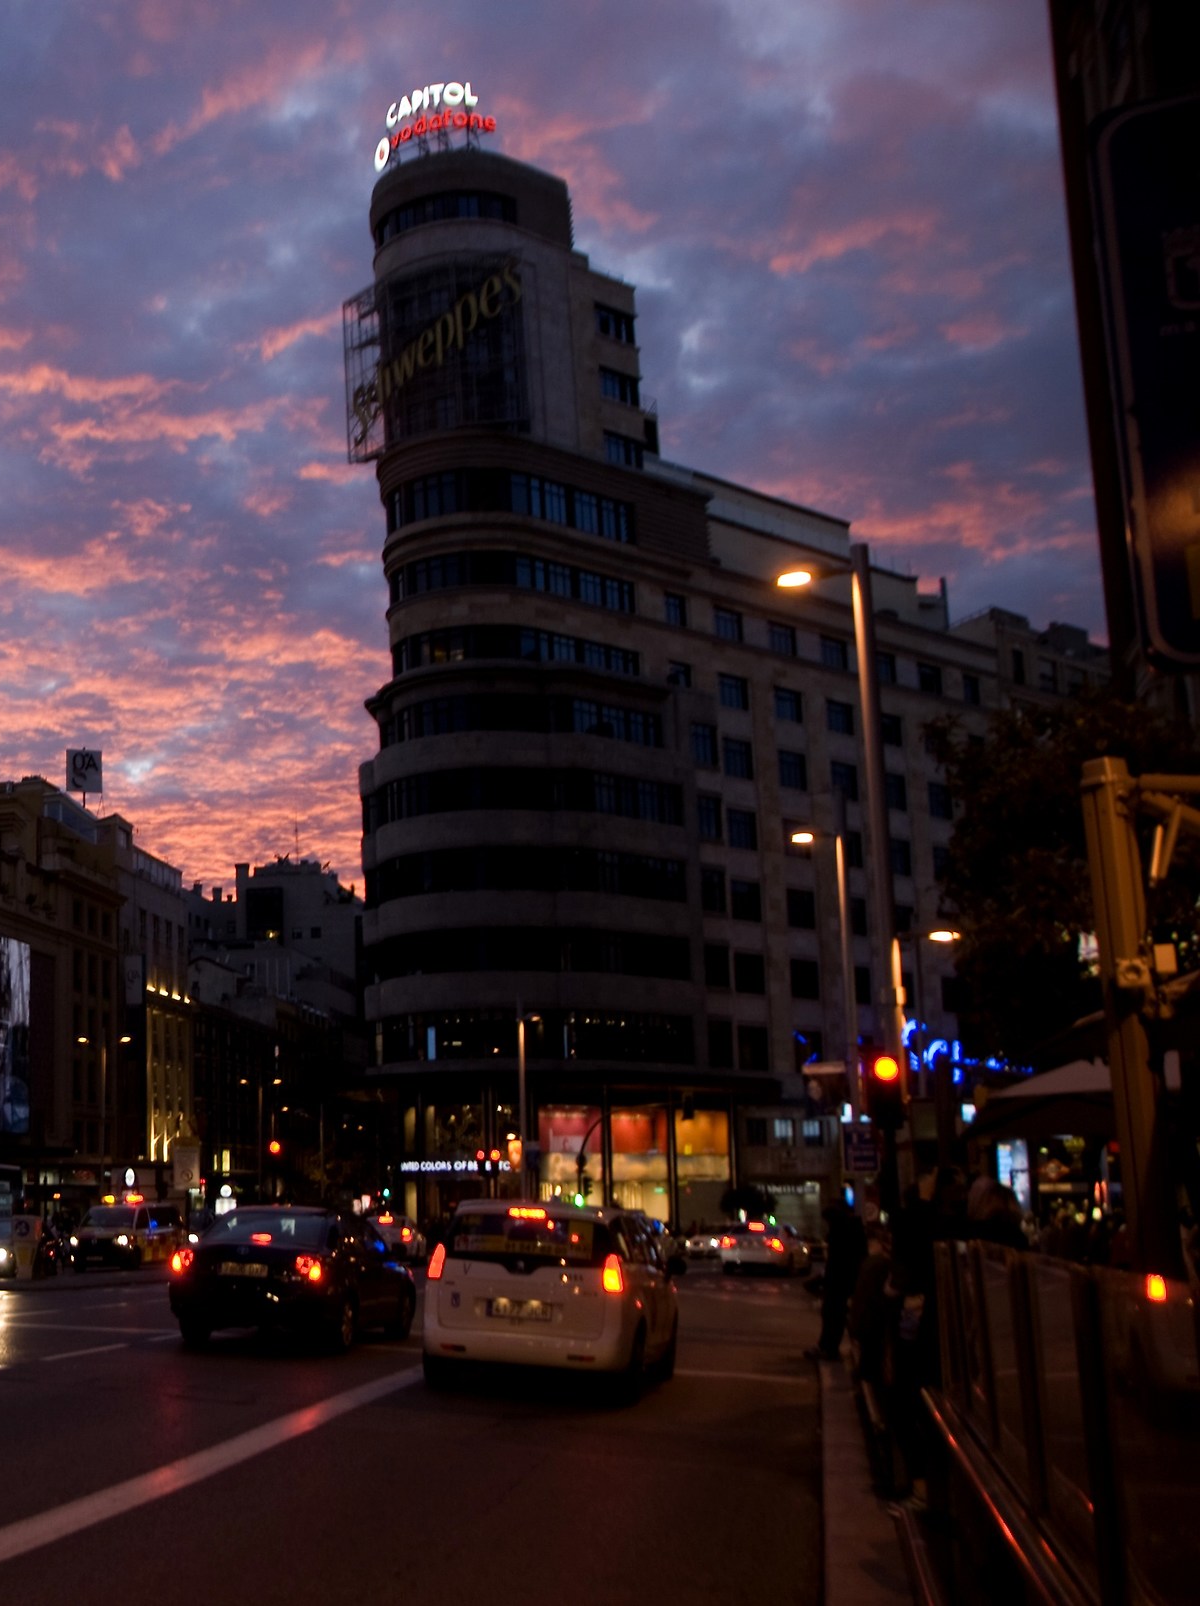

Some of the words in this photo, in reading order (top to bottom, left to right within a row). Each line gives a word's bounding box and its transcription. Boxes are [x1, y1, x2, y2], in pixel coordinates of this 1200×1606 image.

[386, 82, 479, 128] CAPITOL
[390, 107, 497, 149] vodafone
[353, 256, 522, 447] Schweppes
[420, 1160, 451, 1171] COLORS
[453, 1160, 467, 1171] OF
